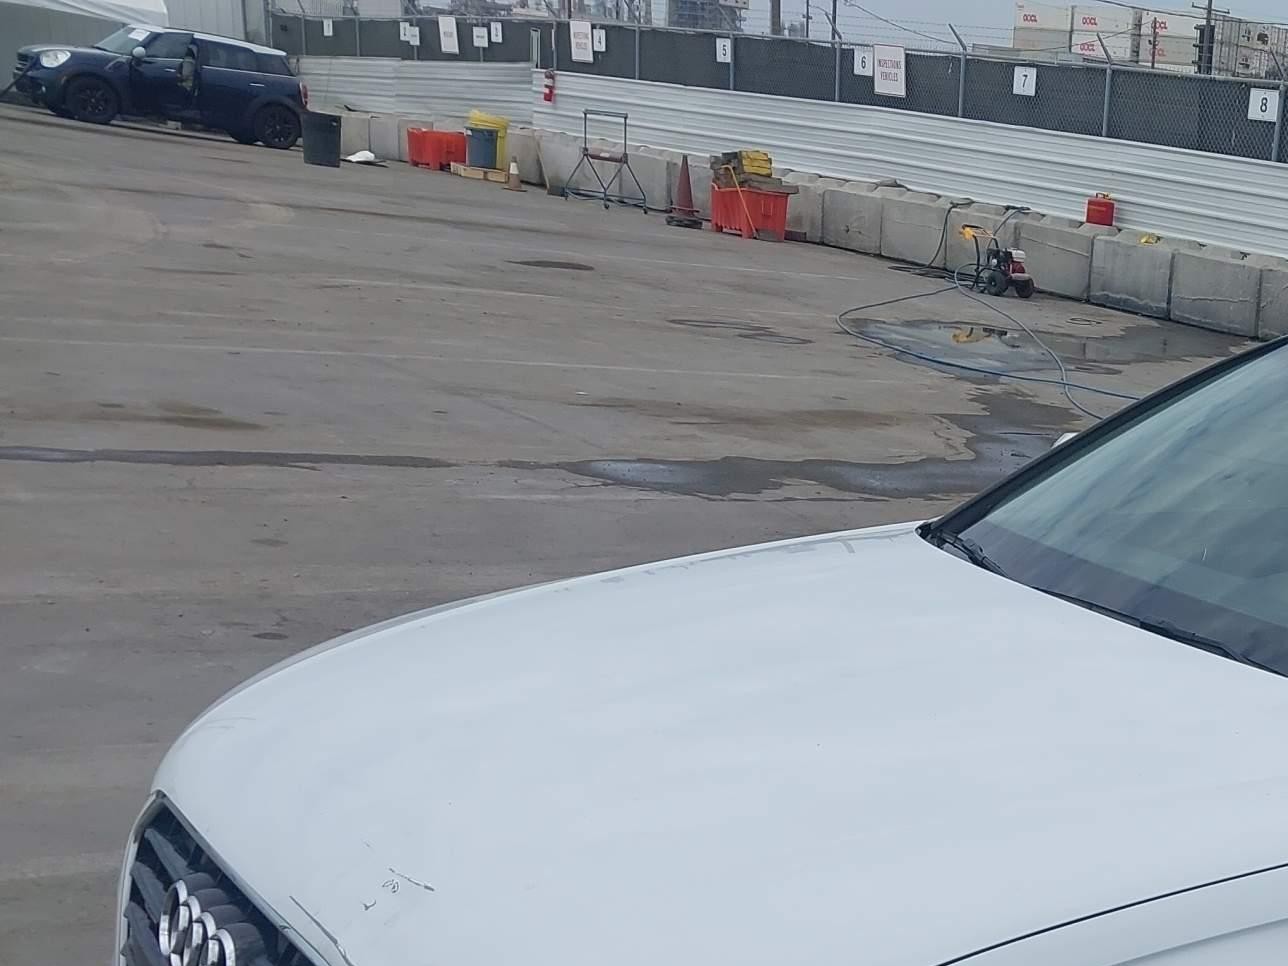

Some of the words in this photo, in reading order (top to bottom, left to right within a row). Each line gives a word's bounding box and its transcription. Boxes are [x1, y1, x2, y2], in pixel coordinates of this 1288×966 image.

[1023, 14, 1037, 22] OOCL
[1082, 17, 1097, 25] OOCL
[722, 44, 727, 56] 5
[861, 55, 867, 69] 6
[1022, 74, 1028, 88] 7
[1260, 97, 1268, 113] 8
